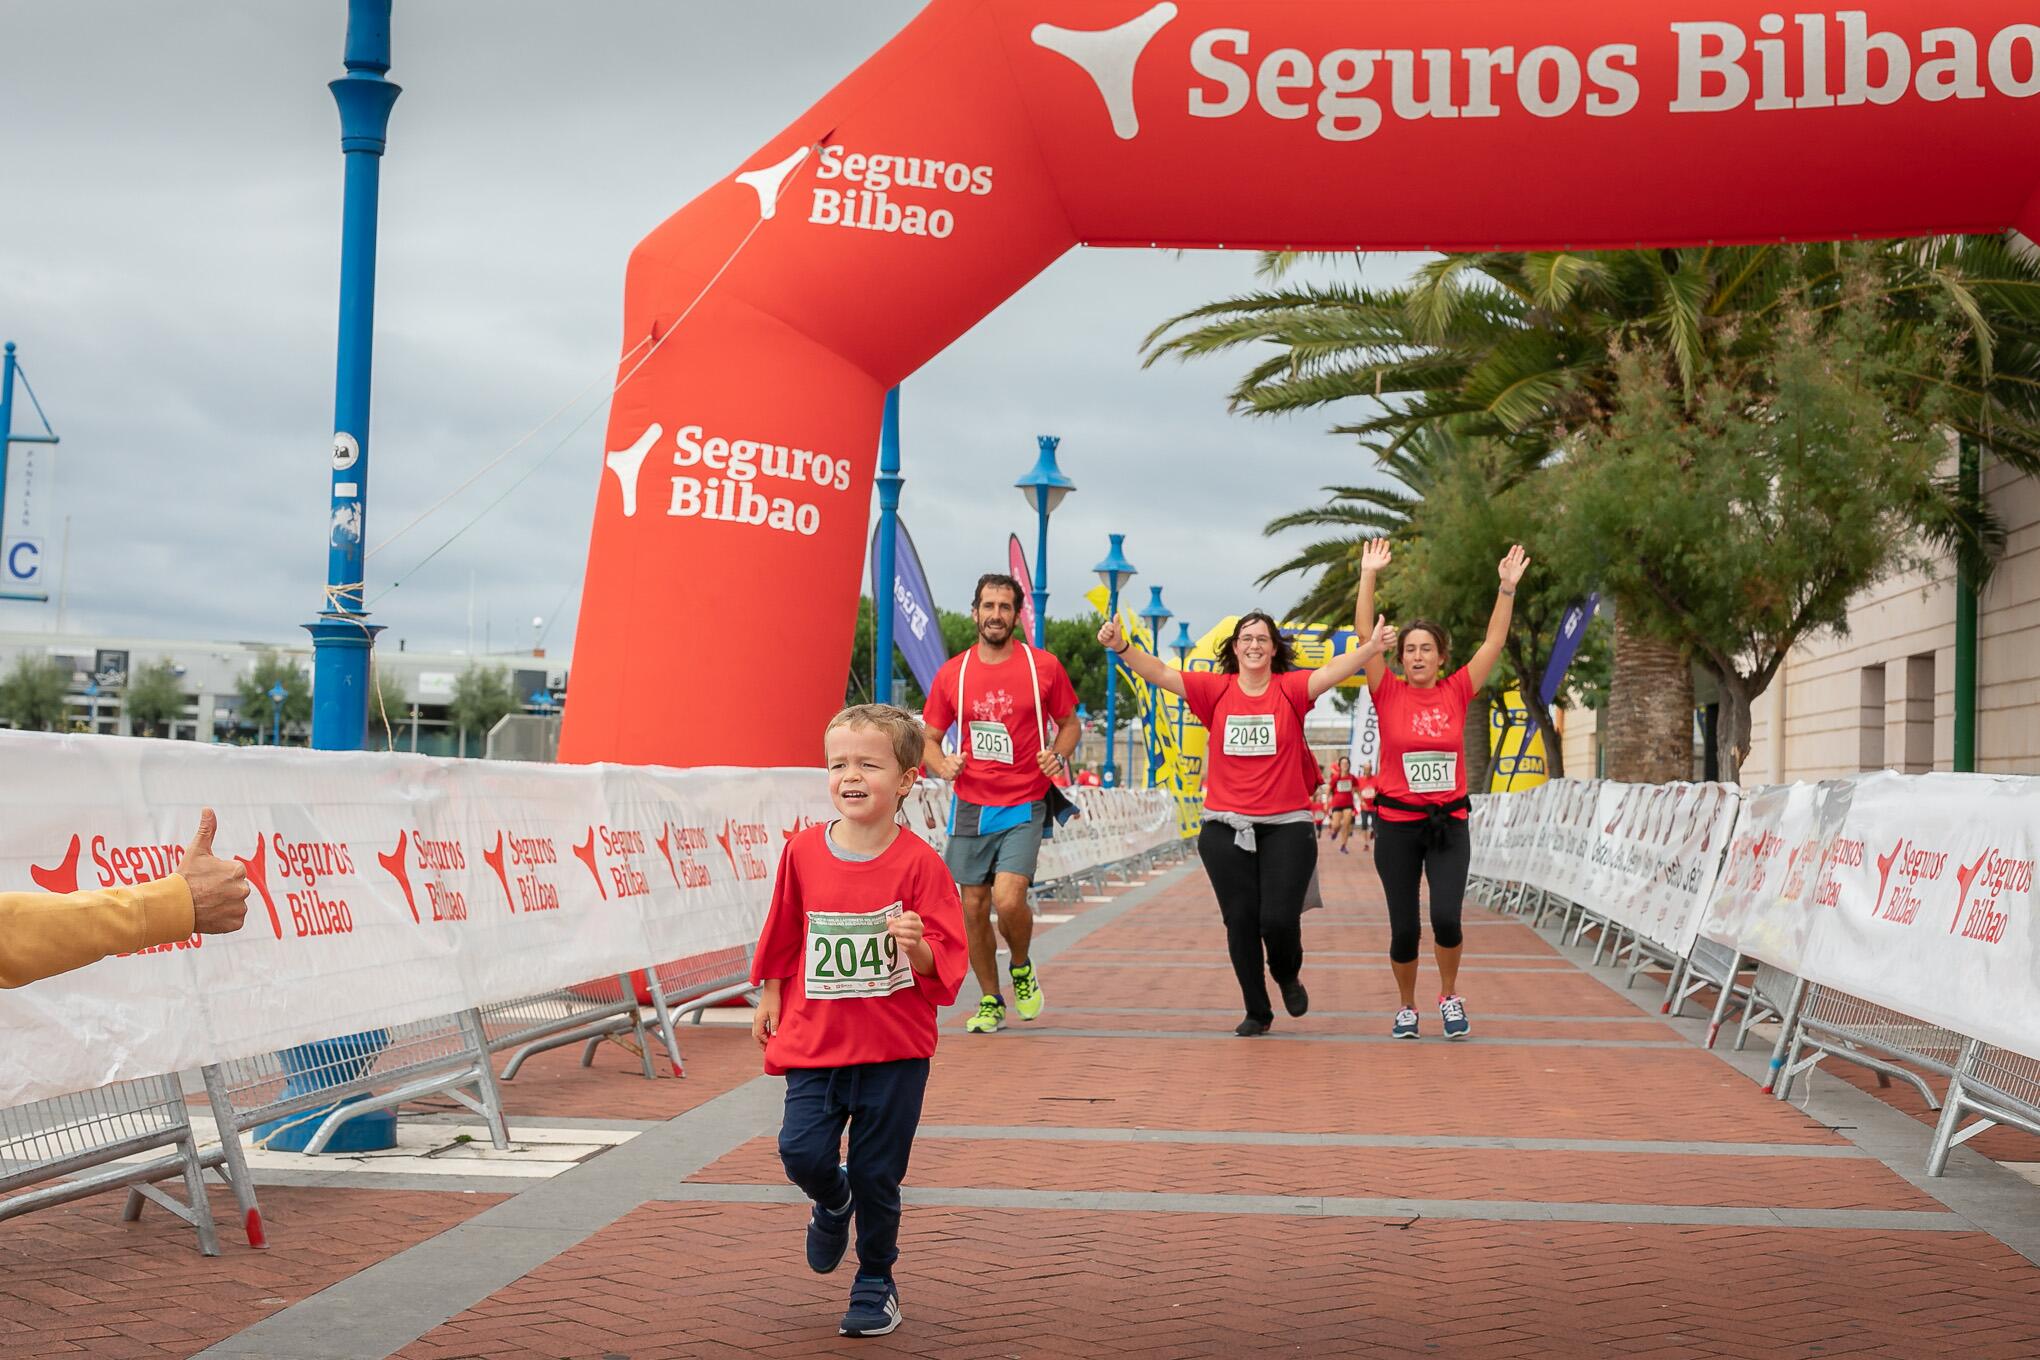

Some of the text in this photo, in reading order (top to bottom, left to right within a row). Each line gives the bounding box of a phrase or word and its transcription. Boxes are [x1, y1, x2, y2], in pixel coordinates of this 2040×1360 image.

[1188, 10, 2040, 141] Seguros Bilbao
[815, 144, 993, 196] Seguros
[808, 187, 954, 239] Bilbao
[673, 425, 850, 491] Seguros
[666, 476, 820, 535] Bilbao
[8, 541, 38, 579] C
[976, 732, 1009, 753] 2051
[1229, 726, 1270, 745] 2049
[1410, 762, 1449, 782] 2051
[273, 832, 355, 887] Seguros
[508, 830, 557, 872] Seguros
[740, 852, 768, 881] ilbao
[1899, 840, 1948, 885] Seguros
[1980, 848, 2035, 897] Seguros
[286, 889, 353, 938] Bilbao
[425, 881, 468, 921] Bilbao
[517, 874, 560, 912] Bilbao
[1882, 886, 1921, 925] Bilbao
[1961, 898, 2008, 944] Bilbao
[814, 936, 898, 977] 2049
